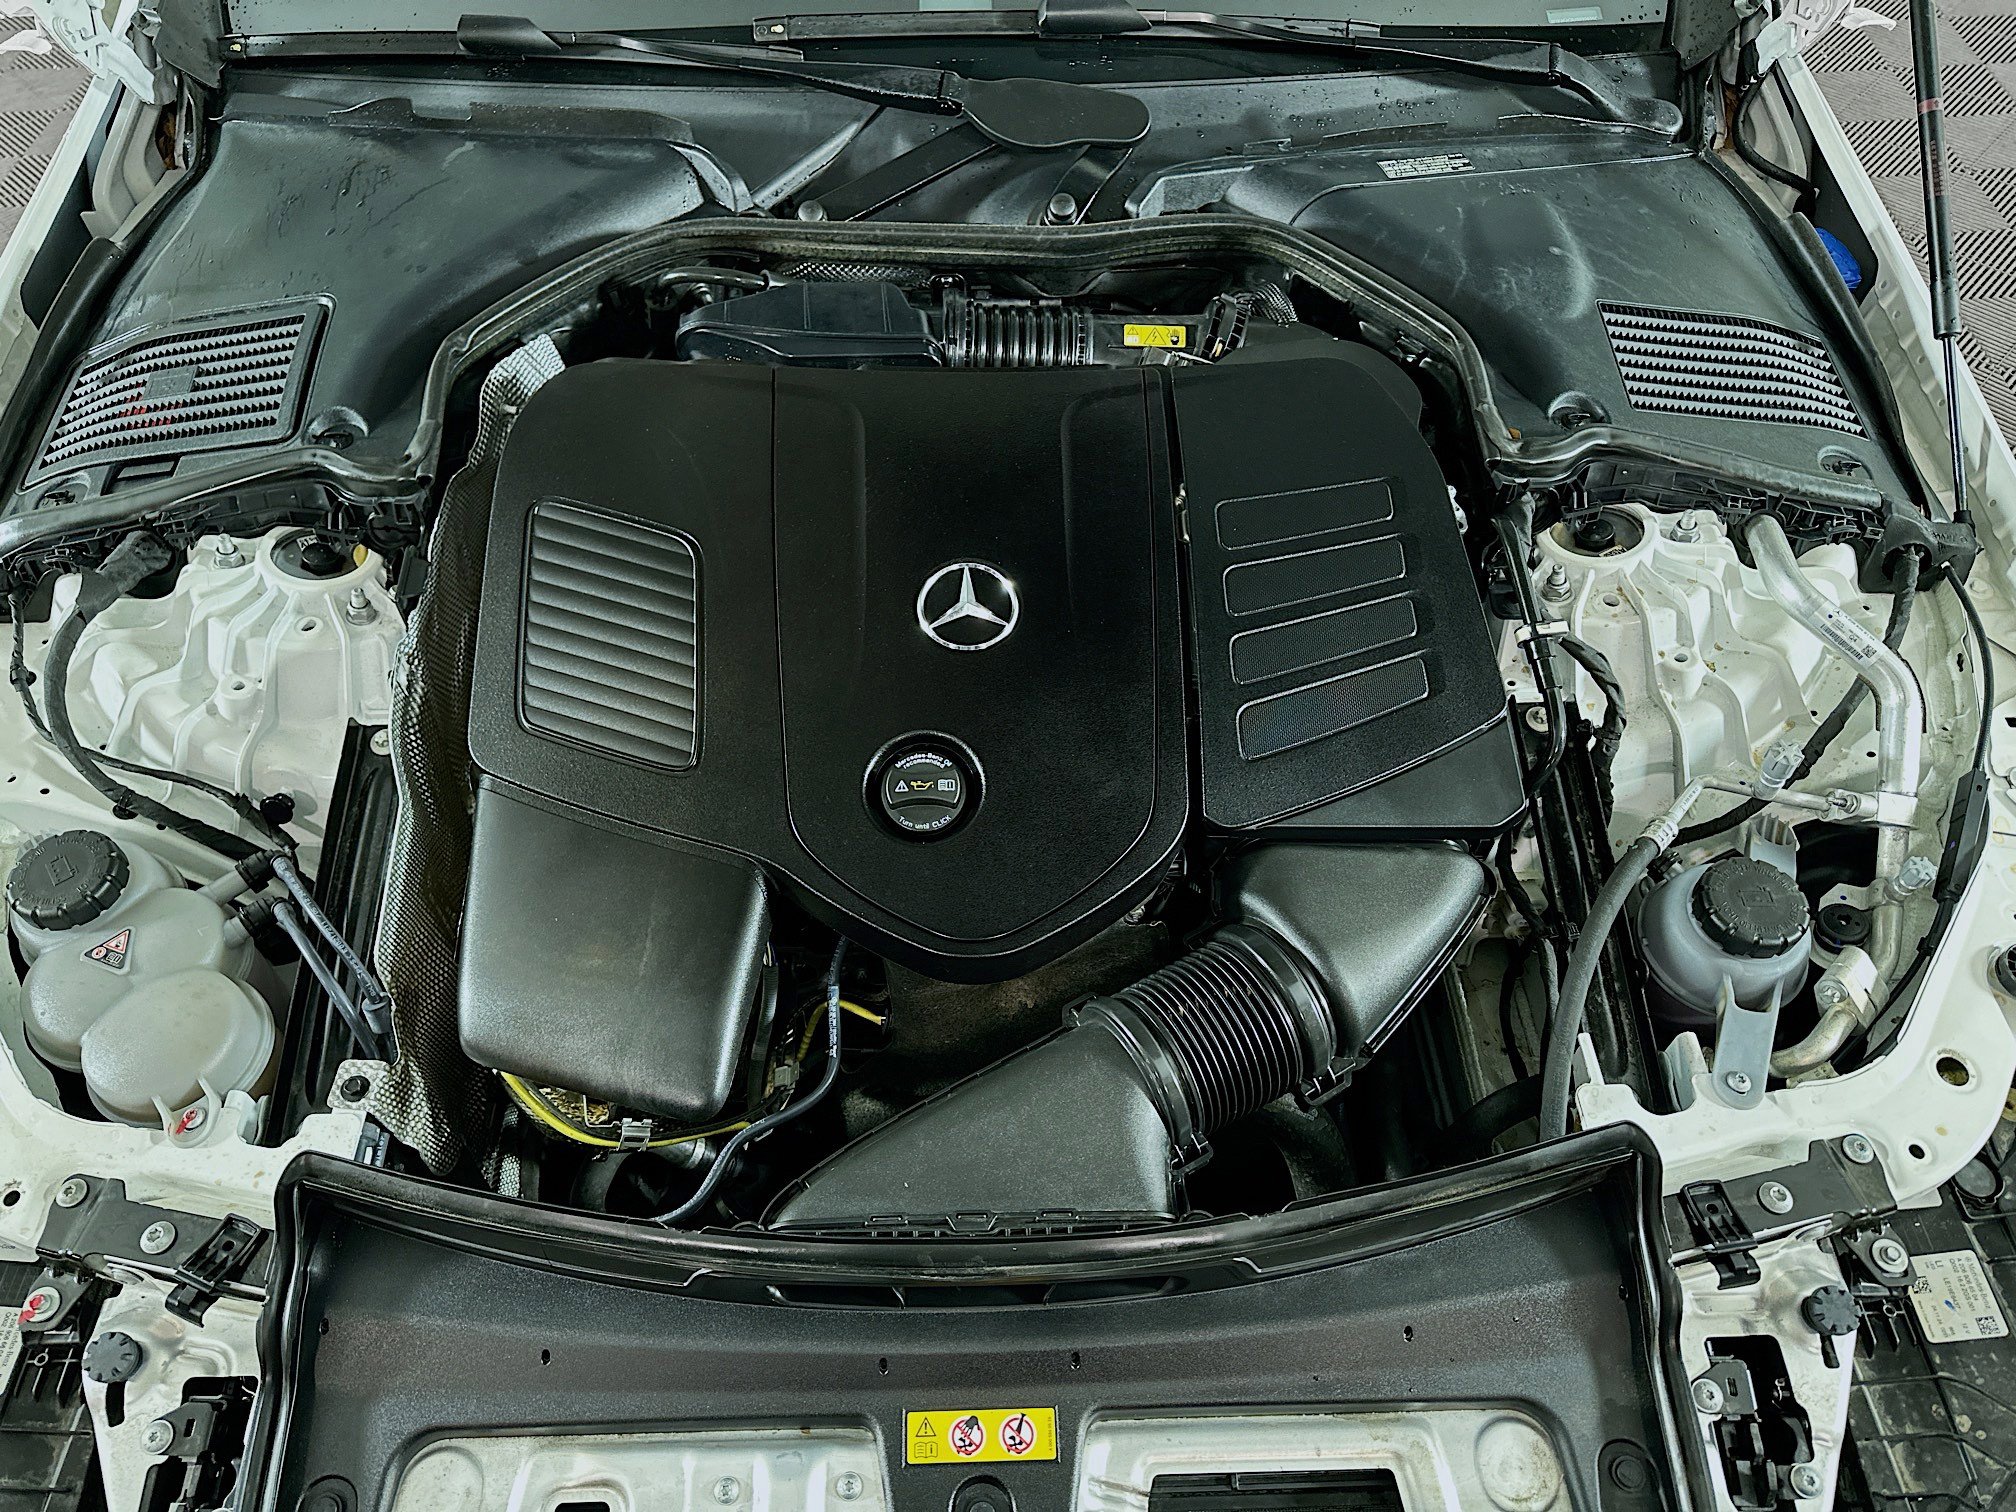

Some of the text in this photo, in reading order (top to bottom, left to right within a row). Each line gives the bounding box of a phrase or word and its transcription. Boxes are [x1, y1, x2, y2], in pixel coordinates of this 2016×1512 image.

[895, 753, 943, 768] Mercedes-Benz
[903, 759, 945, 769] recommended
[899, 815, 913, 827] Turn
[932, 814, 952, 827] CLICK
[1969, 1262, 1991, 1309] Mercedes-Benz
